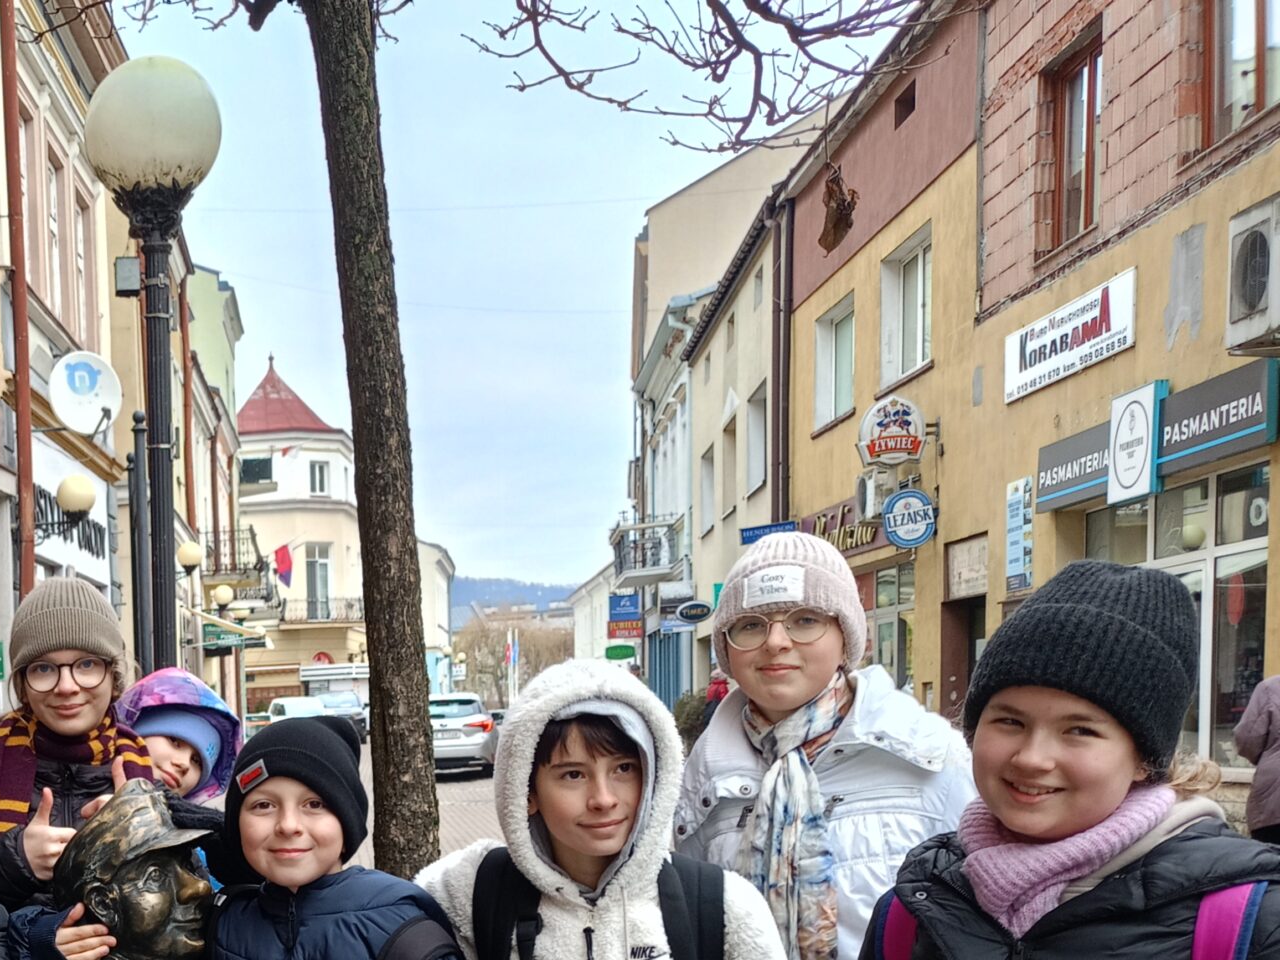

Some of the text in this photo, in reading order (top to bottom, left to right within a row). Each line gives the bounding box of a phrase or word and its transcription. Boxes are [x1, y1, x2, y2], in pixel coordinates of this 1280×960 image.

[1017, 382, 1028, 394] 013
[1163, 392, 1263, 447] PASMANTERIA
[1039, 449, 1110, 489] PASMANTERIA
[761, 574, 785, 583] Cozy
[759, 584, 788, 595] Vibes
[631, 946, 656, 959] NIKE
